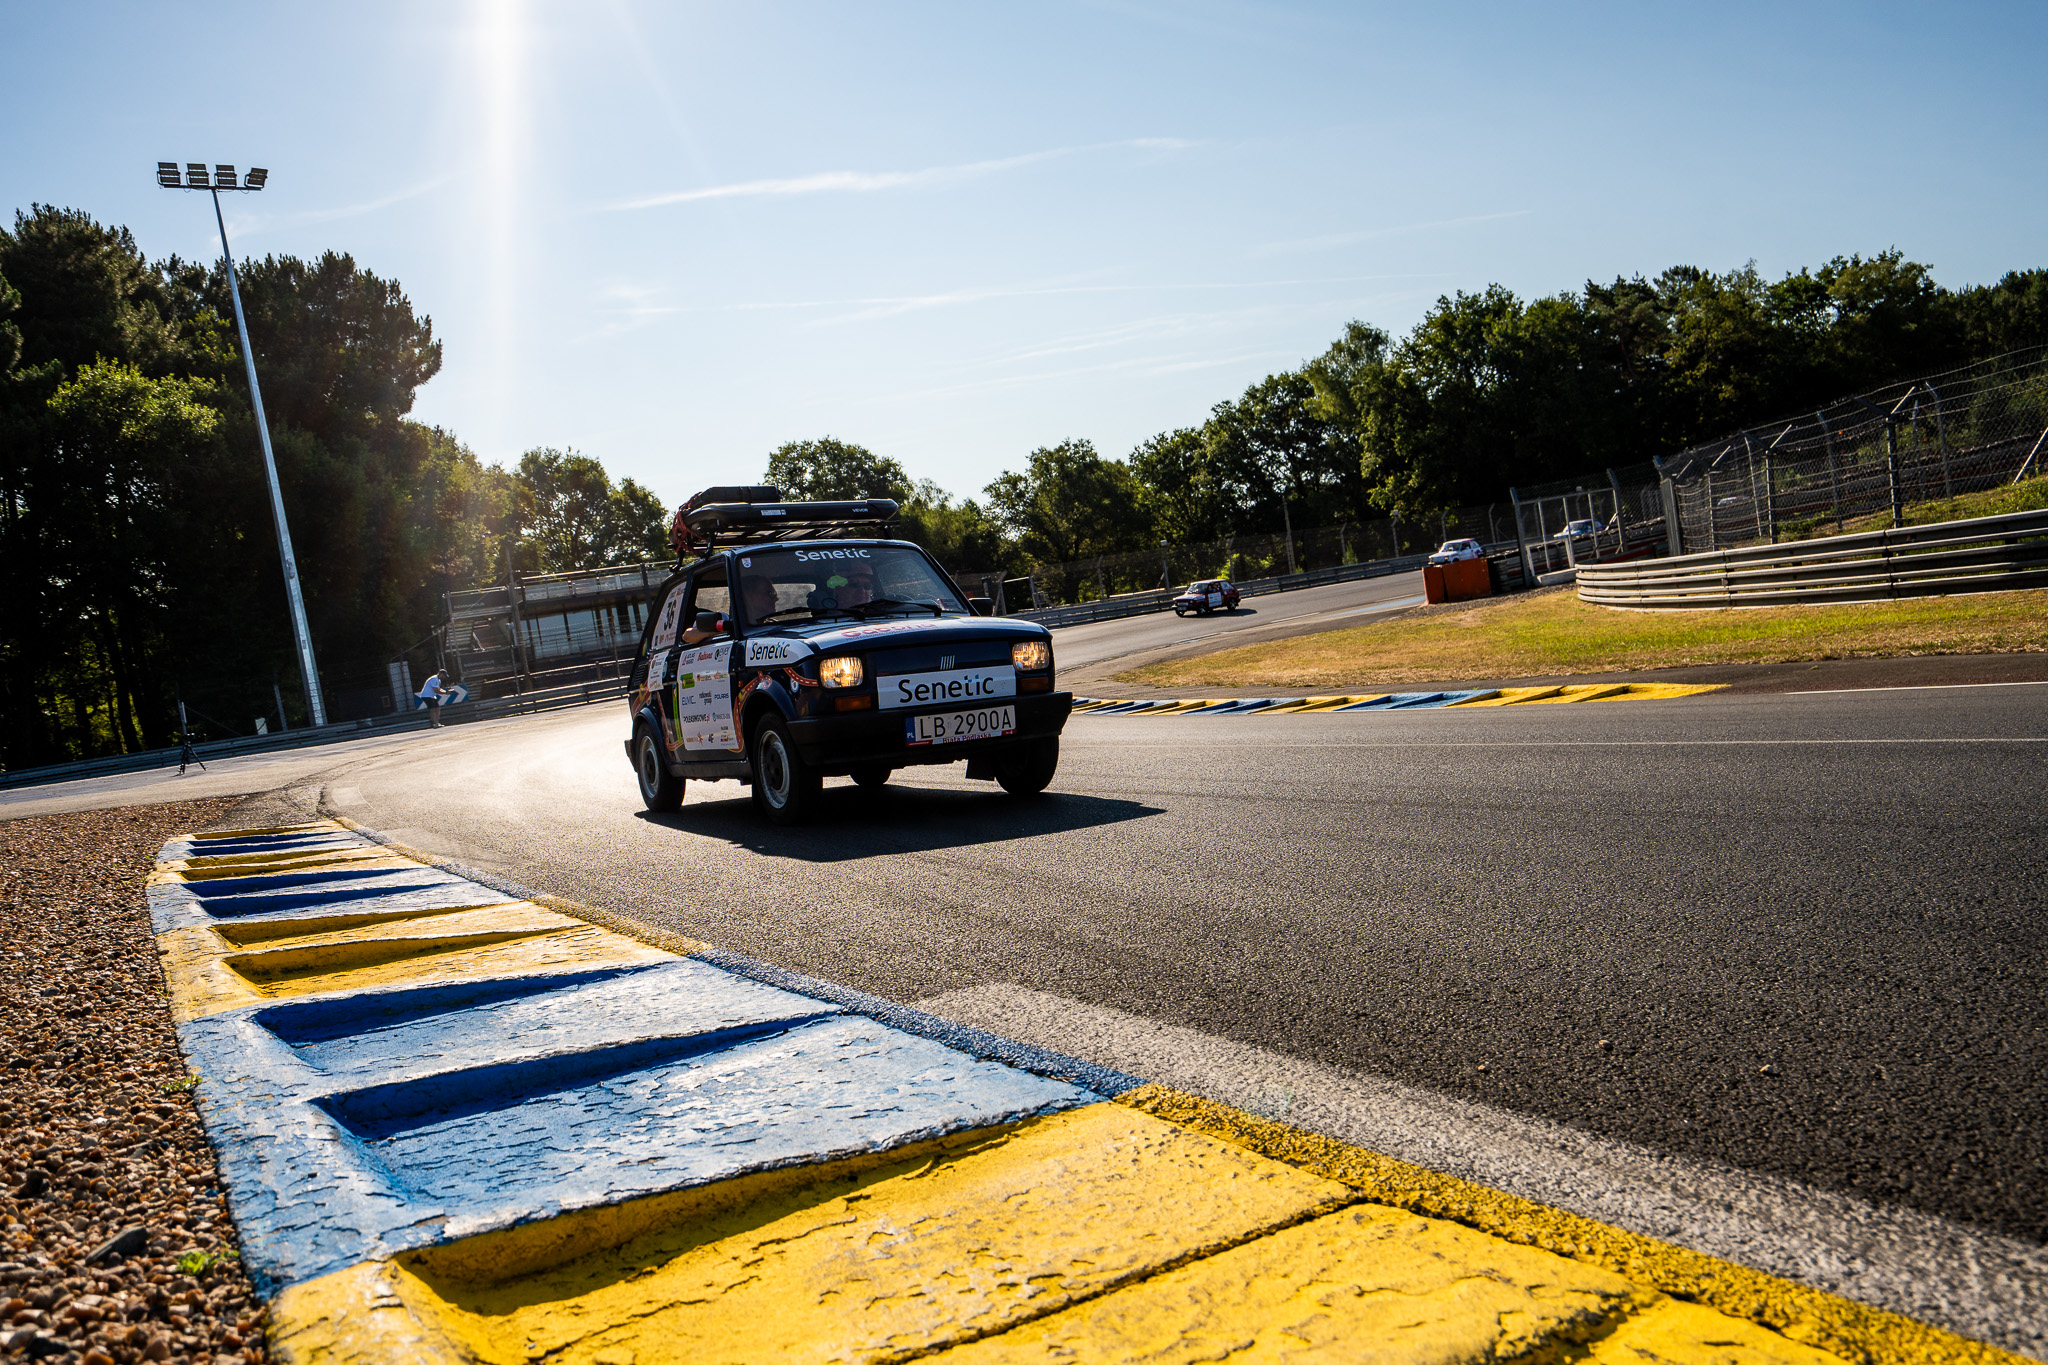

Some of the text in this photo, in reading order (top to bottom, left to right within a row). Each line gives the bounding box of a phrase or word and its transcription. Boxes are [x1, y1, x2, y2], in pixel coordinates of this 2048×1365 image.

[794, 548, 871, 562] Senetic
[663, 599, 677, 631] 36
[749, 641, 790, 661] Senetic
[898, 674, 995, 703] Senetic
[920, 708, 1012, 739] LB 2900A
